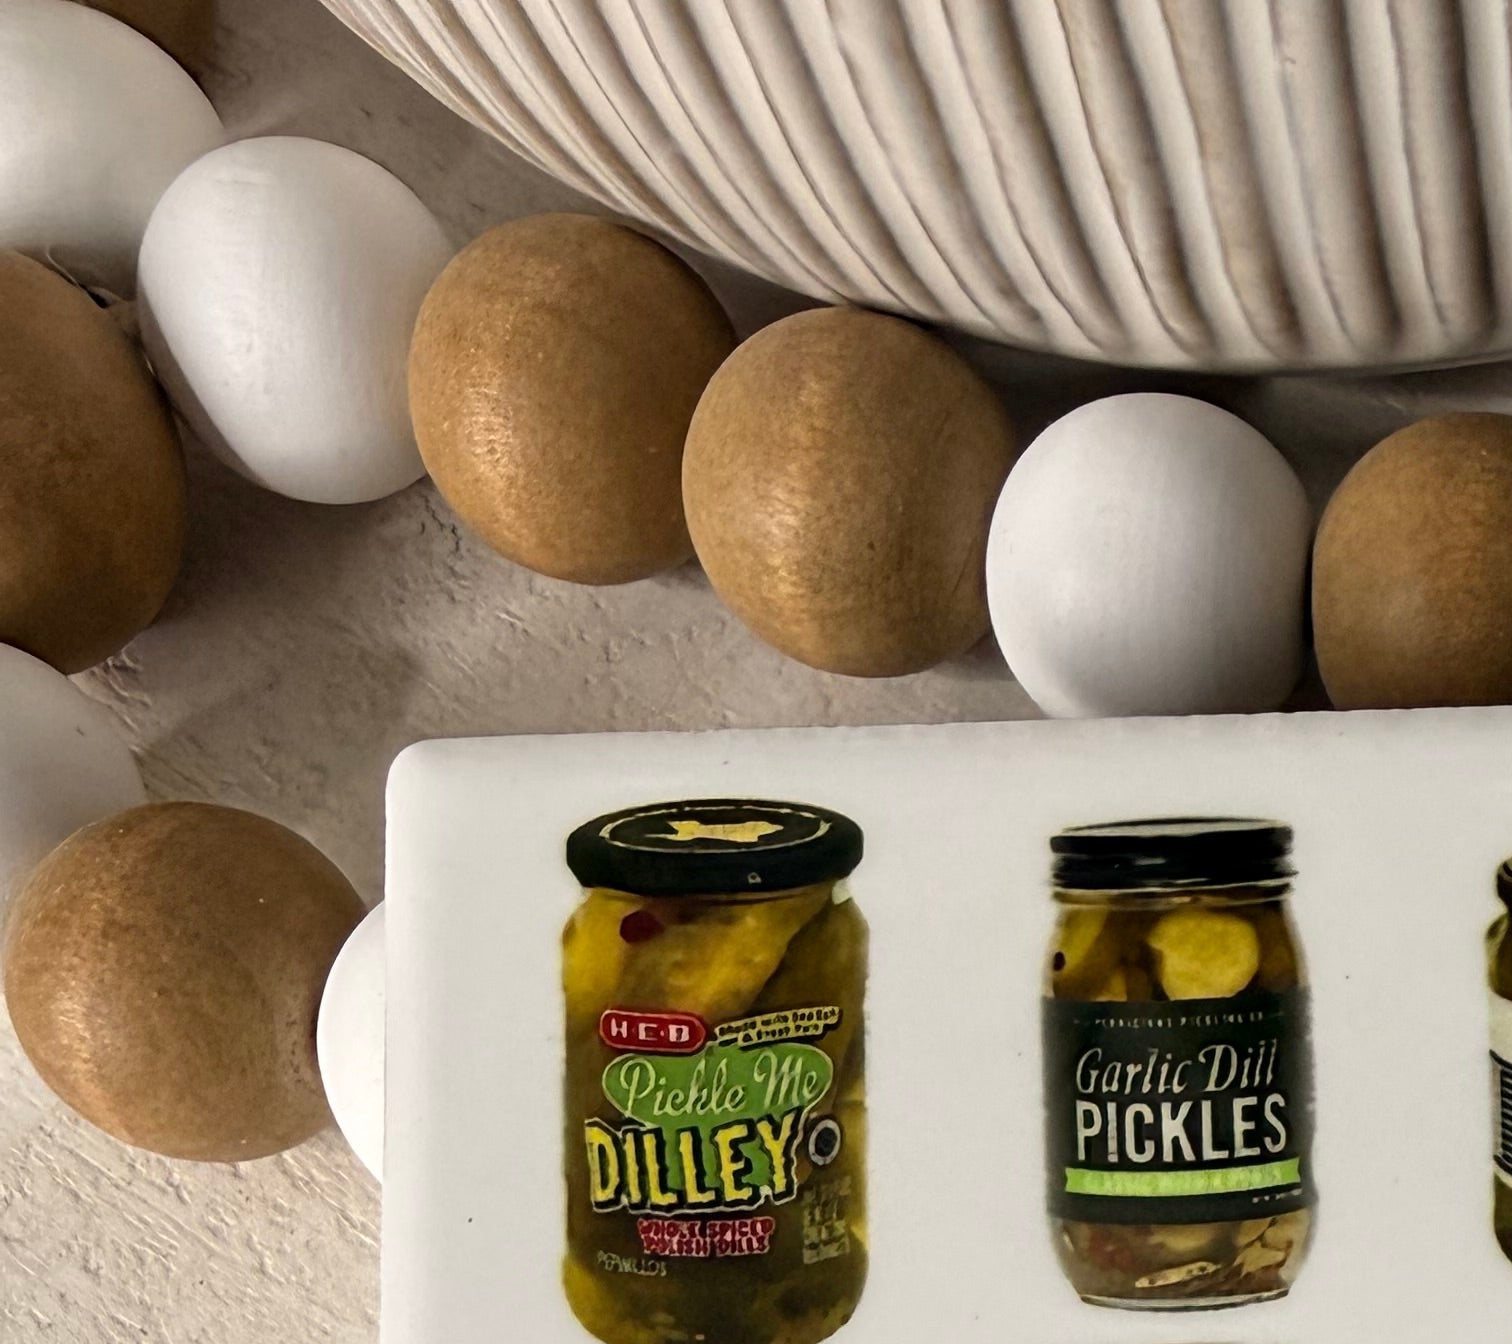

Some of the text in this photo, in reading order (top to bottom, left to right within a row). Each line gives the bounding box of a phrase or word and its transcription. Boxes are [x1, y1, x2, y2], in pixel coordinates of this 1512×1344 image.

[619, 1051, 817, 1117] Pickle Me
[1076, 1039, 1278, 1094] Garlic Dill
[585, 1112, 796, 1205] DILLEY
[1075, 1093, 1287, 1163] PICKLES
